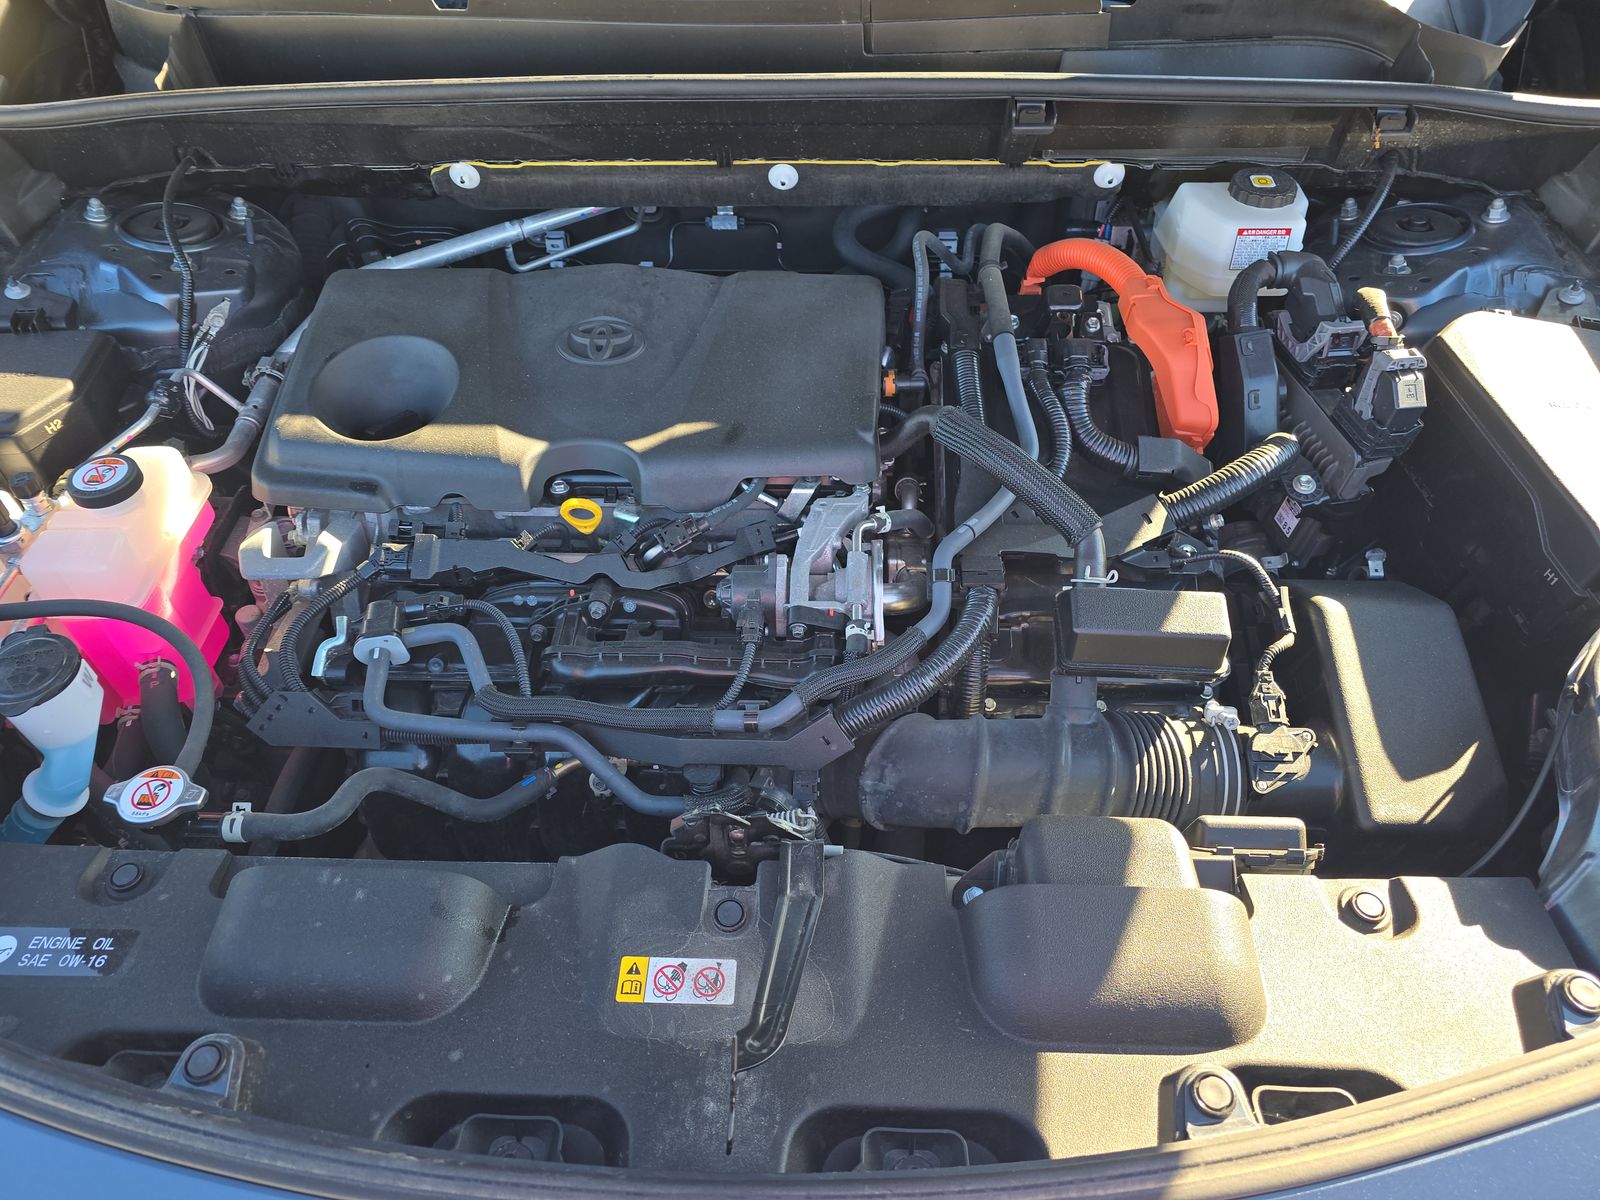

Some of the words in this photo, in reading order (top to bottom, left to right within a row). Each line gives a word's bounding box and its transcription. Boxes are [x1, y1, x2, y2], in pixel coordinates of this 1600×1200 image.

[44, 418, 64, 434] H2
[1543, 568, 1559, 586] H1
[28, 937, 86, 949] ENGINE
[92, 937, 115, 951] OIL
[17, 953, 52, 967] SAE
